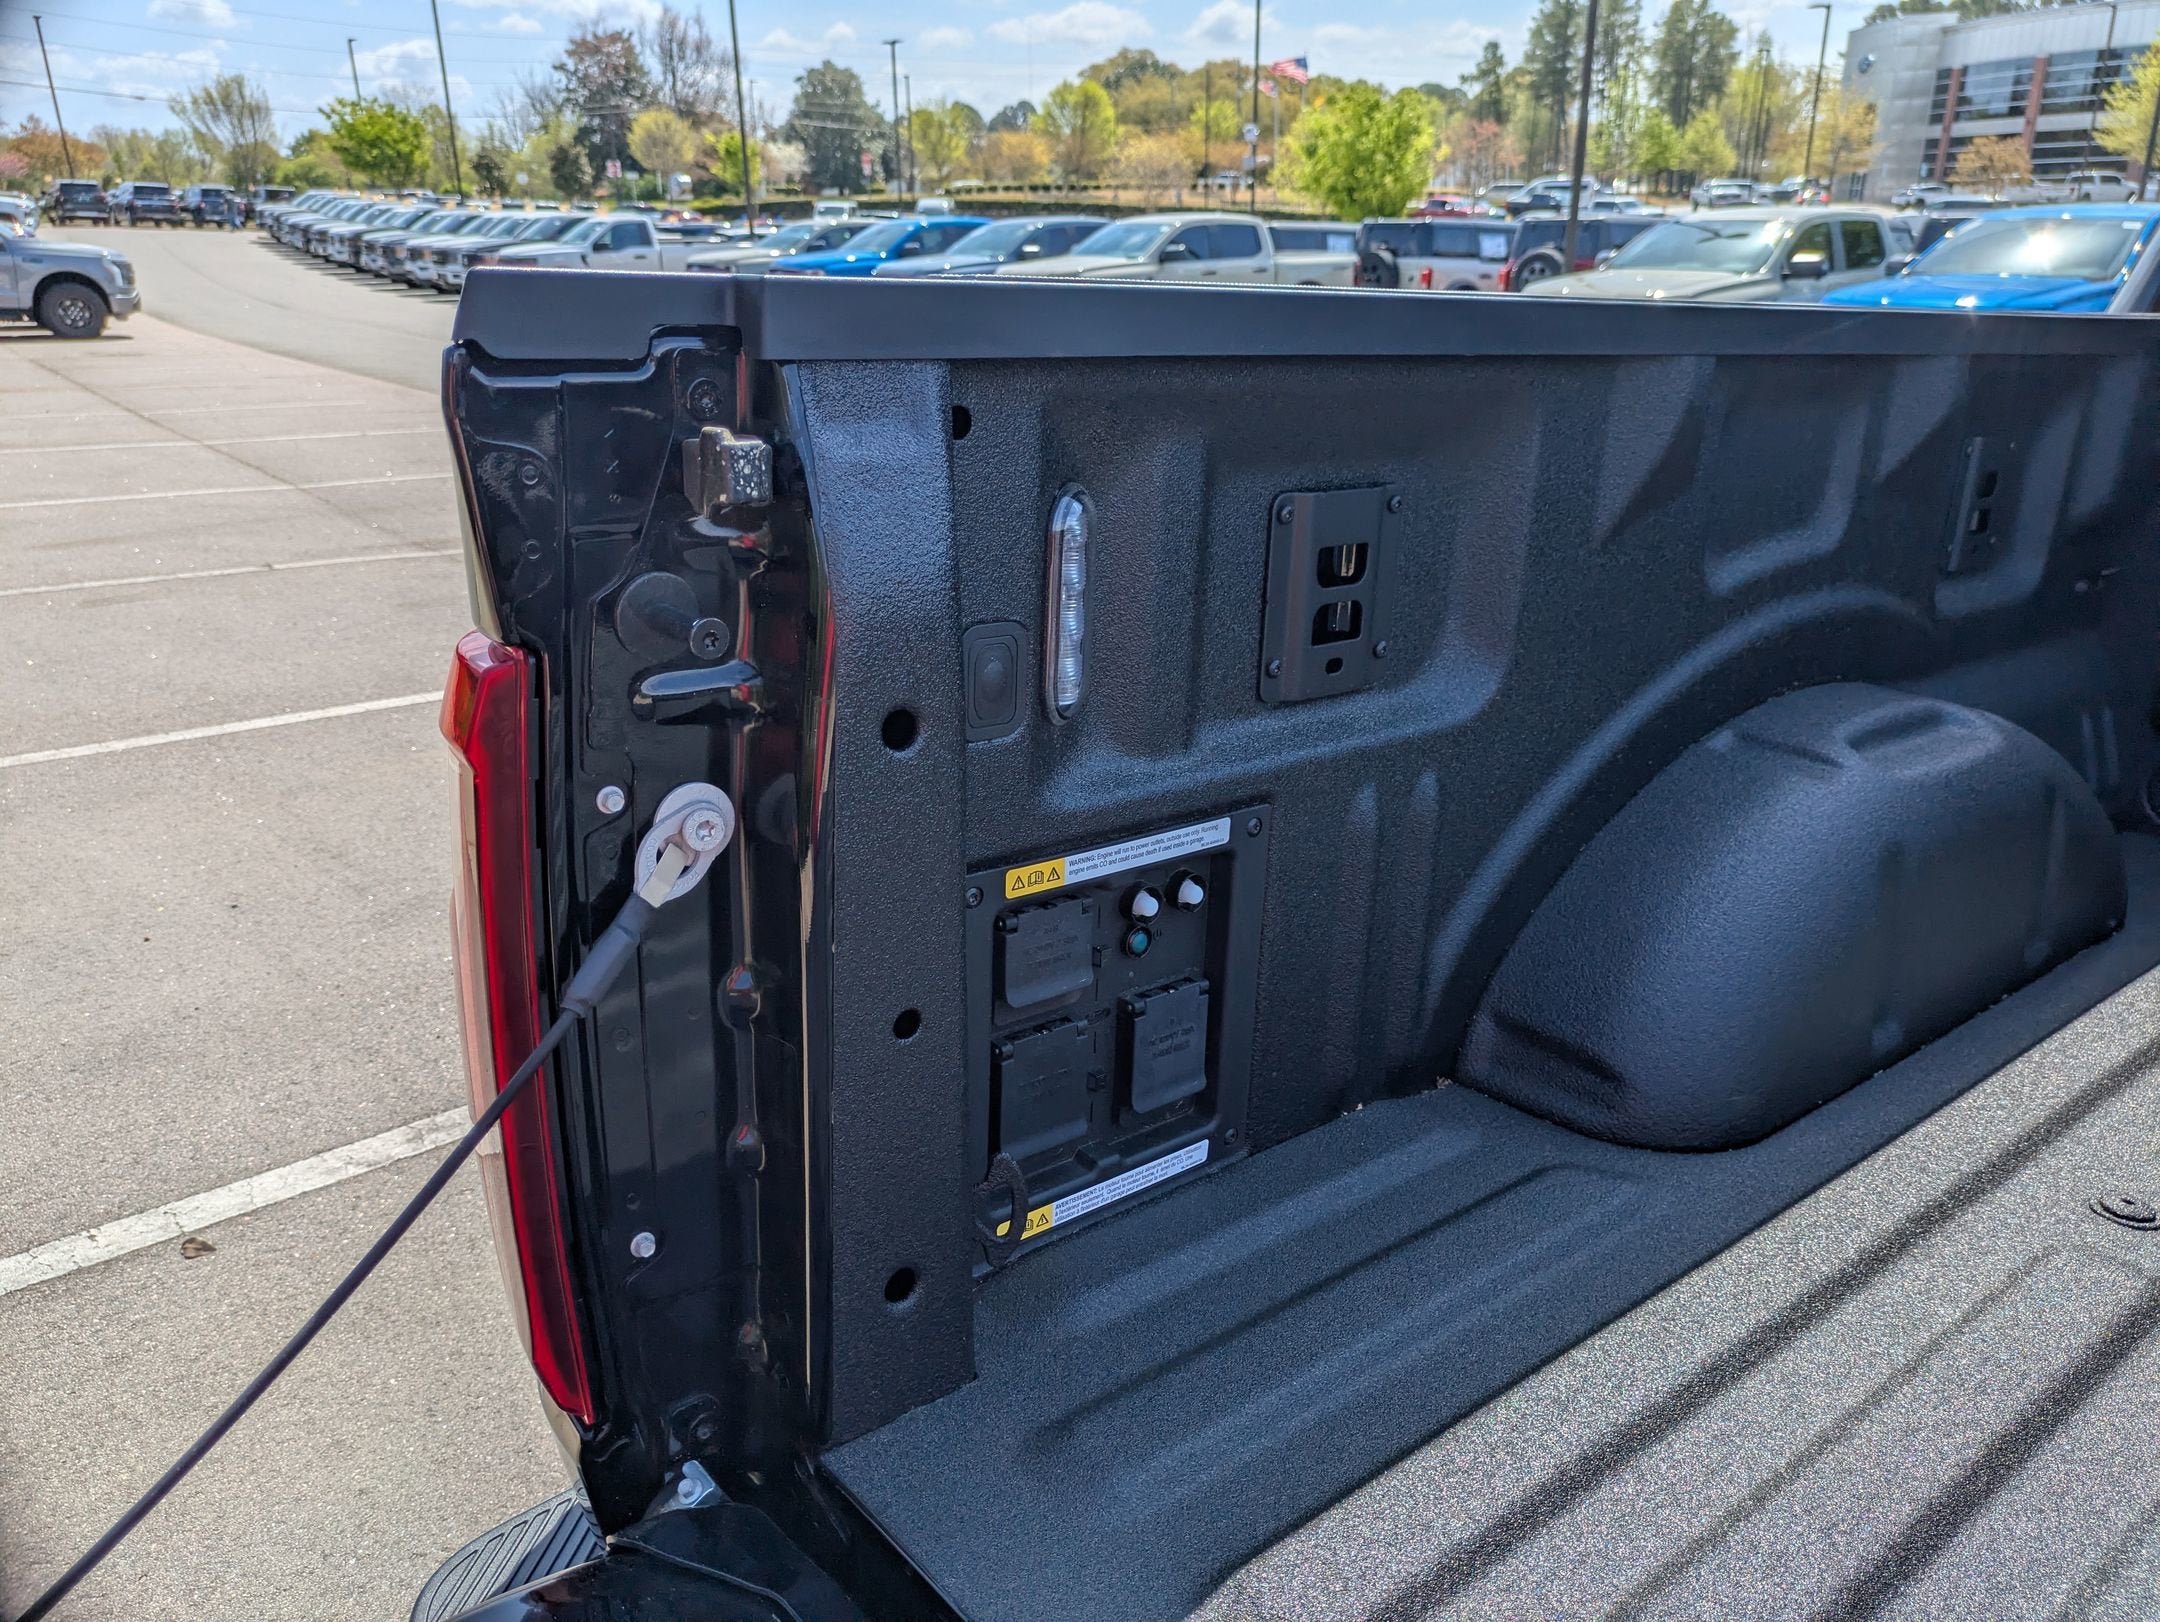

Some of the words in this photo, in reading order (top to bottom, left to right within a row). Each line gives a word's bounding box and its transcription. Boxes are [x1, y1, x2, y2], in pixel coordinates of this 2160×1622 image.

[1069, 855, 1096, 867] WARNING:
[1097, 851, 1113, 861] Engine
[1136, 843, 1150, 851] power
[1167, 834, 1182, 842] outside
[1201, 824, 1218, 835] Running
[1069, 867, 1085, 877] engine
[1086, 863, 1098, 871] emits
[1109, 858, 1117, 866] and
[1118, 855, 1130, 863] could
[1131, 852, 1144, 860] cause
[1145, 848, 1158, 856] death
[1162, 844, 1172, 852] used
